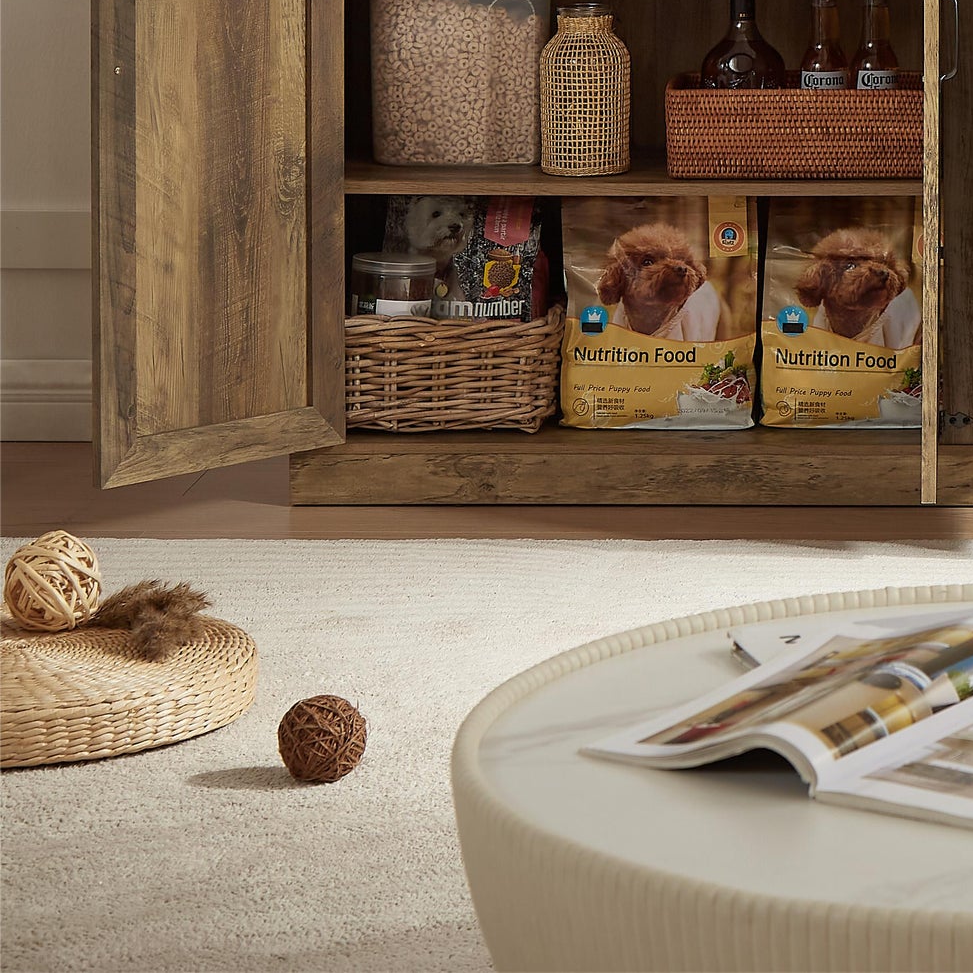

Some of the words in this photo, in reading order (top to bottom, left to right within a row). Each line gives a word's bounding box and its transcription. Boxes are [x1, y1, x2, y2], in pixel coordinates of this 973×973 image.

[803, 73, 845, 88] Corona
[861, 73, 901, 88] Coron
[474, 297, 526, 317] number
[574, 346, 649, 363] Nutrition
[654, 346, 696, 363] Food
[775, 348, 850, 367] Nutrition
[855, 351, 897, 369] Food
[574, 383, 586, 391] Full
[587, 383, 606, 392] Price
[608, 384, 631, 393] Puppy
[633, 385, 651, 393] Food
[775, 386, 788, 394] Full
[789, 387, 807, 396] Price
[809, 388, 832, 397] Puppy
[834, 389, 853, 397] Food
